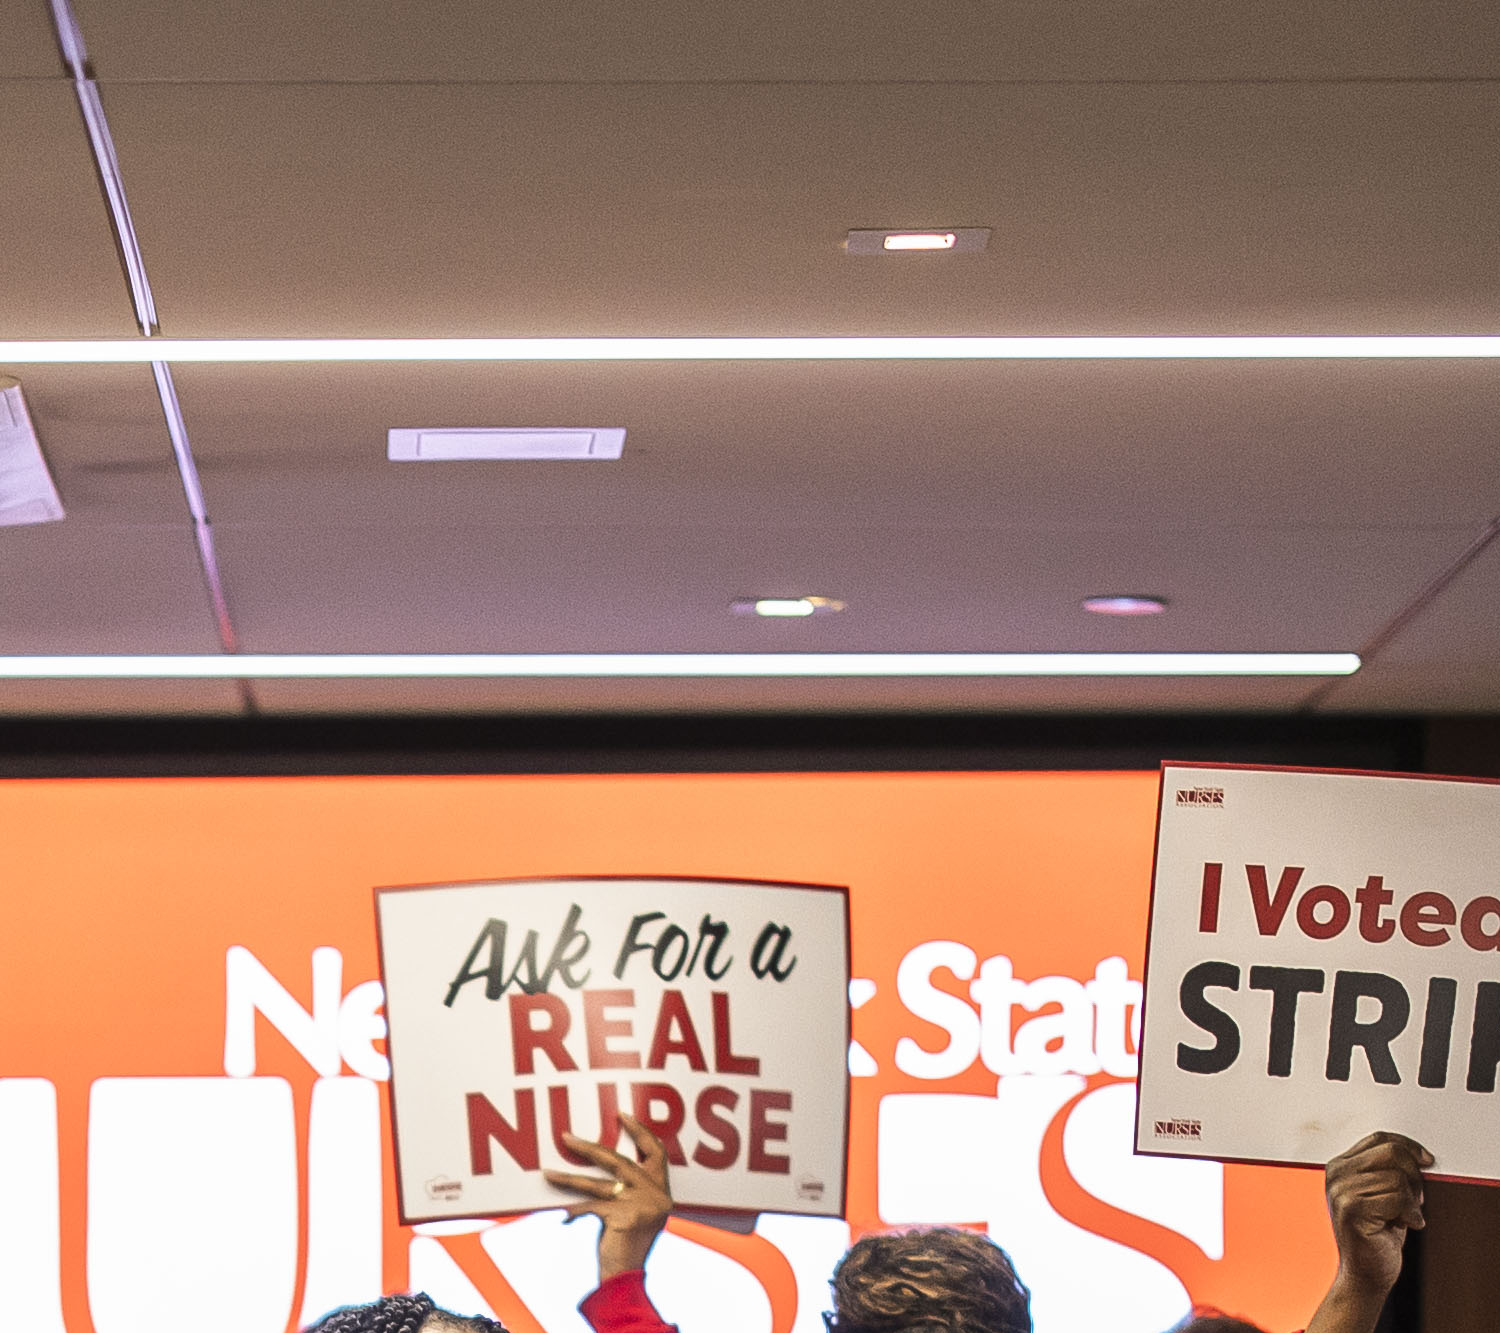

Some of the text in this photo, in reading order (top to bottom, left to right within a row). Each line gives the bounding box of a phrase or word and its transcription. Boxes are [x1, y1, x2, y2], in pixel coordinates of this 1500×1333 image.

[1198, 862, 1223, 932] I
[444, 903, 796, 1008] Ask For a
[507, 989, 761, 1076] REAL
[894, 940, 1146, 1076] Stat
[465, 1081, 793, 1176] NURSE
